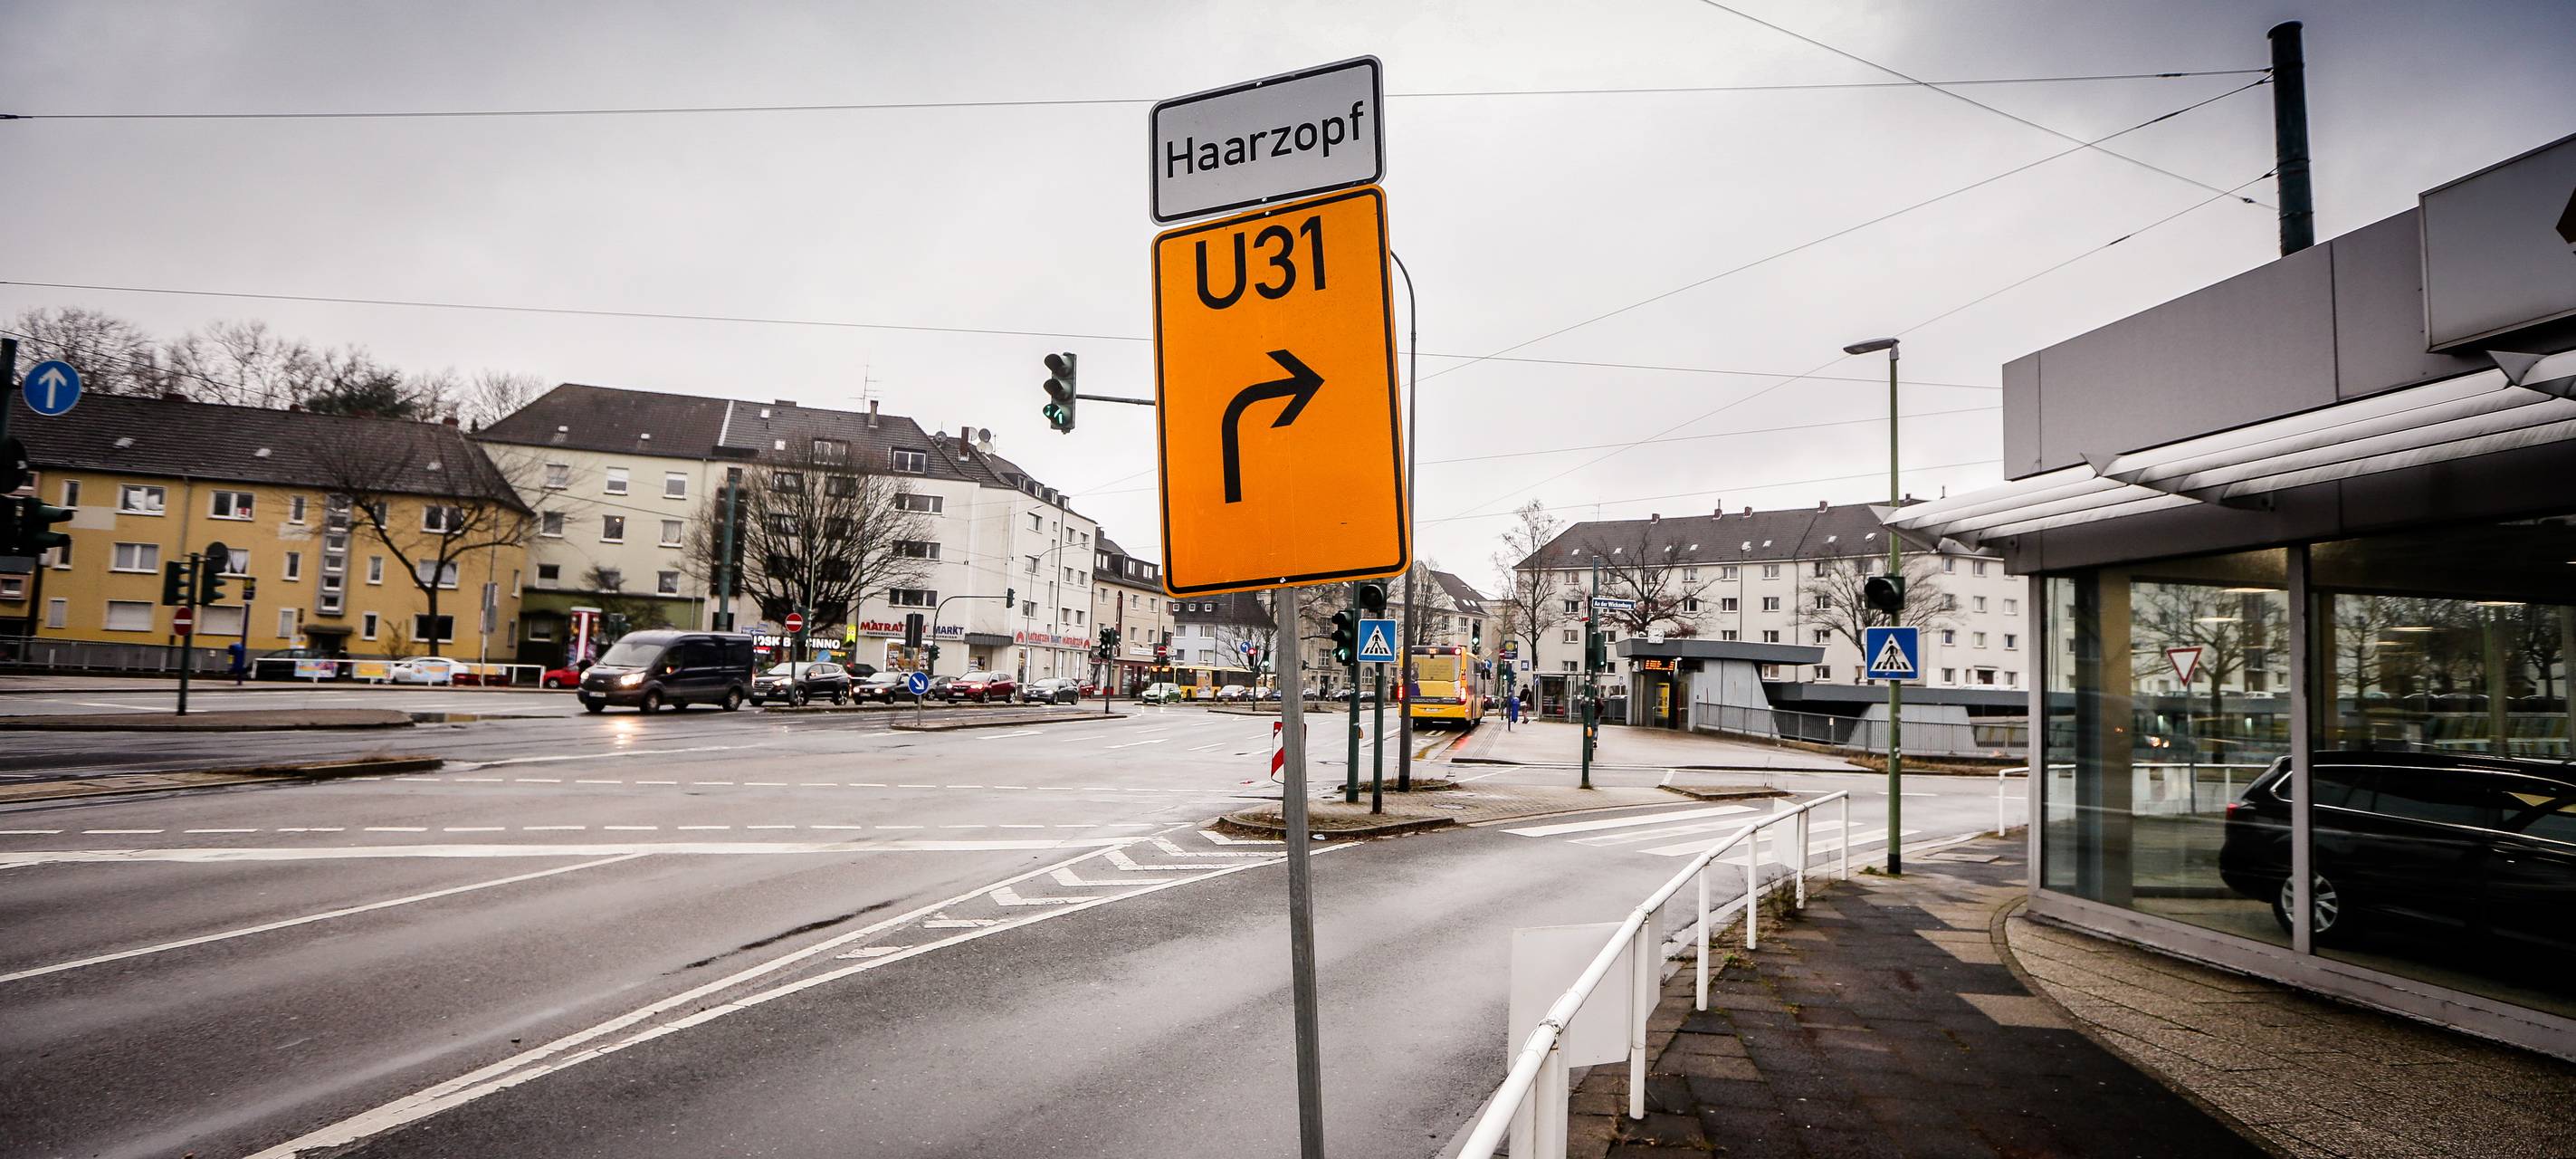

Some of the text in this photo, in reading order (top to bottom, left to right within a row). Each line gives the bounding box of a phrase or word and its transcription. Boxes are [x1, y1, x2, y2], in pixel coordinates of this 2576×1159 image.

[1167, 101, 1364, 178] Haarzopf
[1195, 215, 1326, 310] U31
[753, 635, 780, 647] IOSK
[860, 621, 964, 636] MATRAT MARKT
